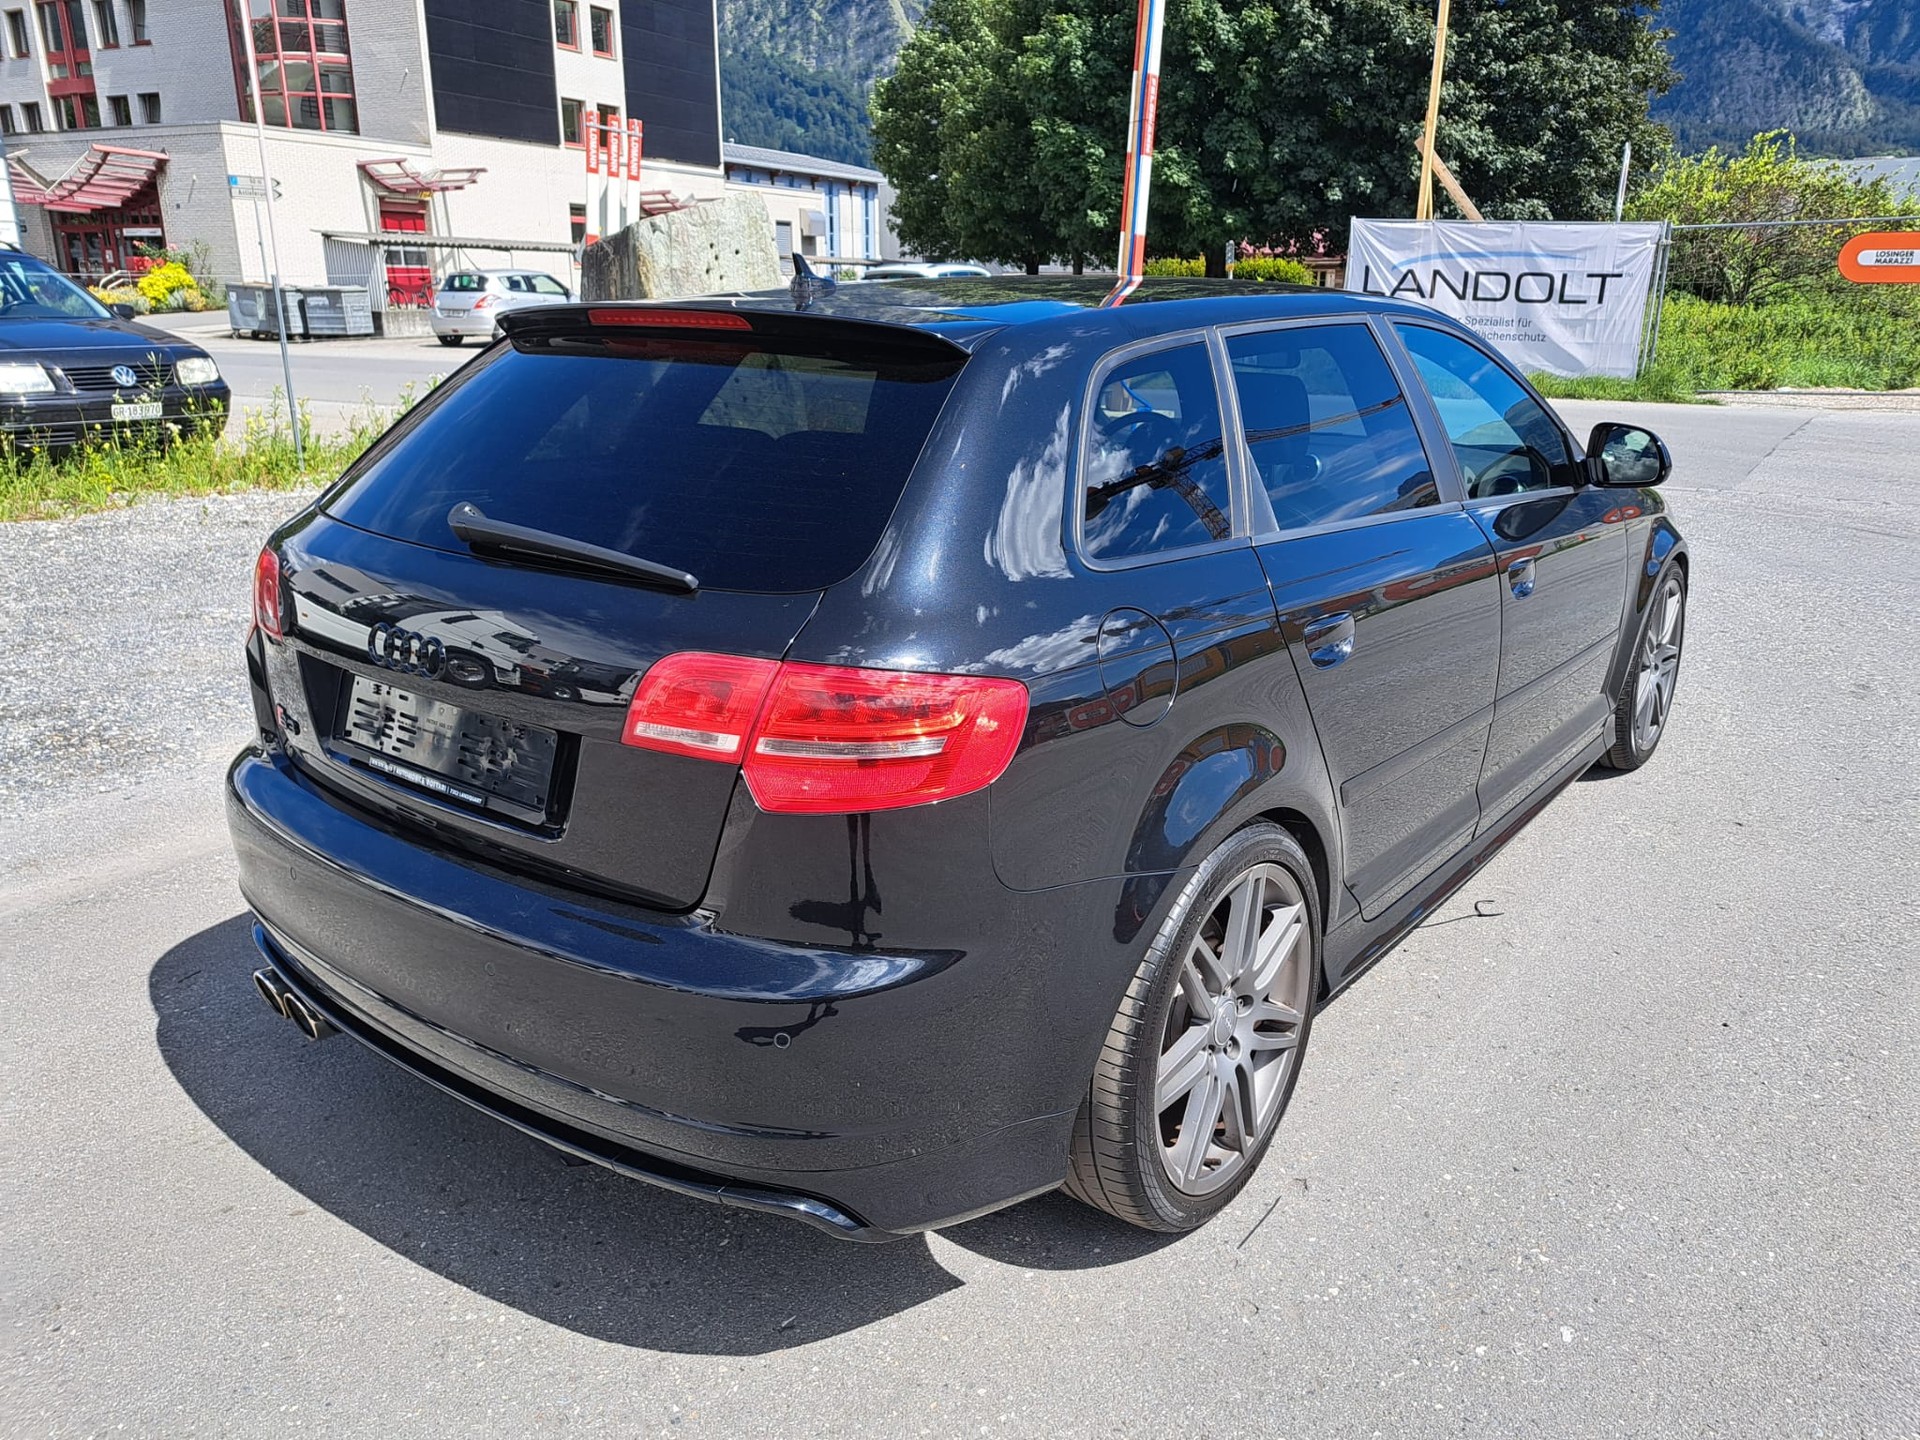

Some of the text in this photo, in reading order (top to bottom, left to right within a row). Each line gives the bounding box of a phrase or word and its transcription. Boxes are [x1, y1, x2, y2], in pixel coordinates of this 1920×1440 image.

[1362, 264, 1623, 305] LANDOLT
[1464, 315, 1515, 328] Spezialist
[1517, 317, 1532, 328] für
